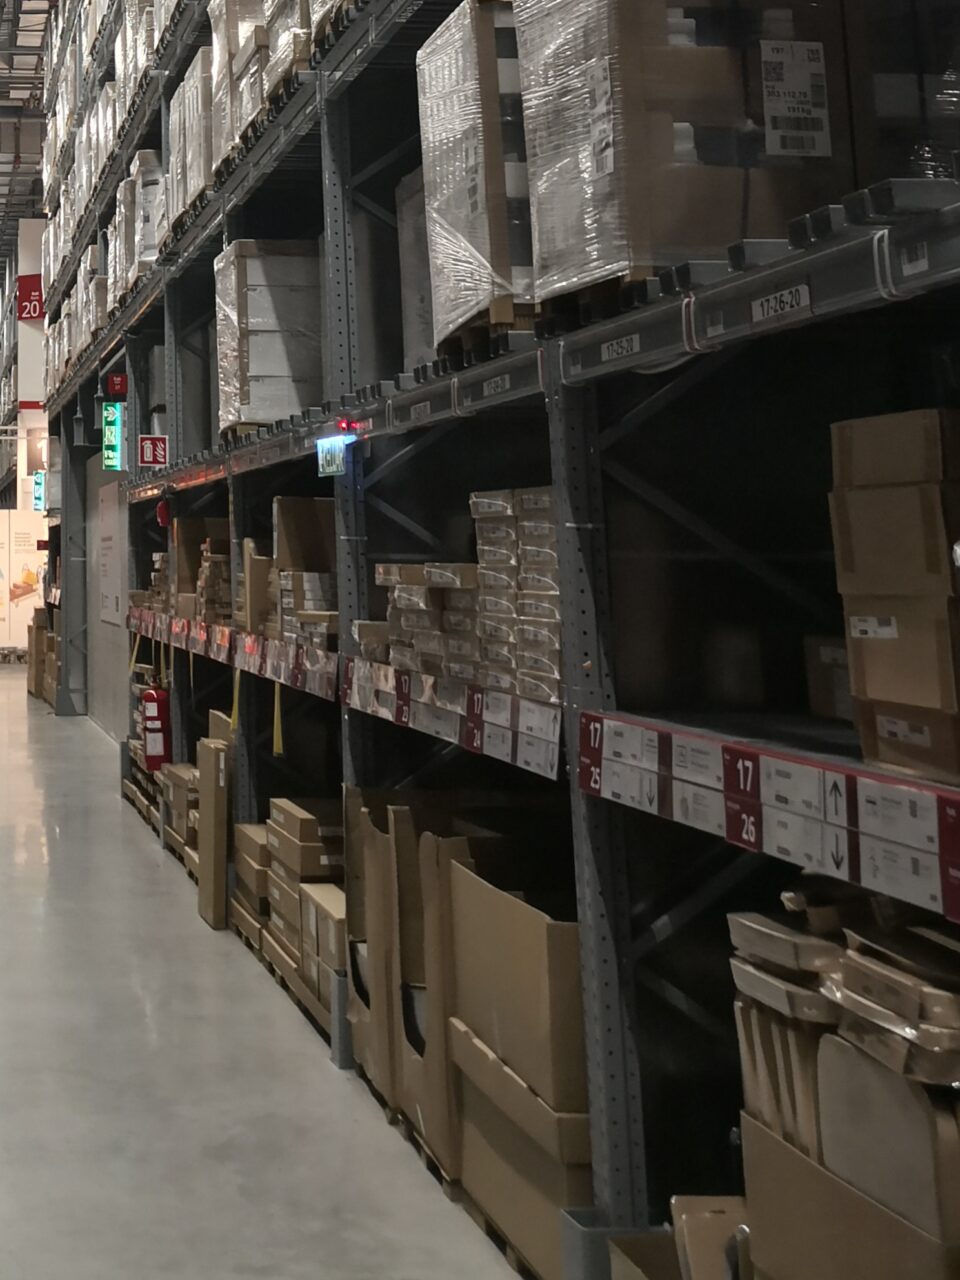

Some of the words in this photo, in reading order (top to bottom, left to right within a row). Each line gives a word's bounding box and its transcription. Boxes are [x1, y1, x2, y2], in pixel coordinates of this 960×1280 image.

[21, 300, 40, 318] 20
[759, 288, 801, 318] 17-26-20
[607, 337, 634, 358] 17-25-20
[473, 693, 482, 714] 17
[589, 721, 601, 749] 17
[589, 766, 600, 790] 25
[736, 758, 752, 792] 17
[740, 813, 755, 843] 26
